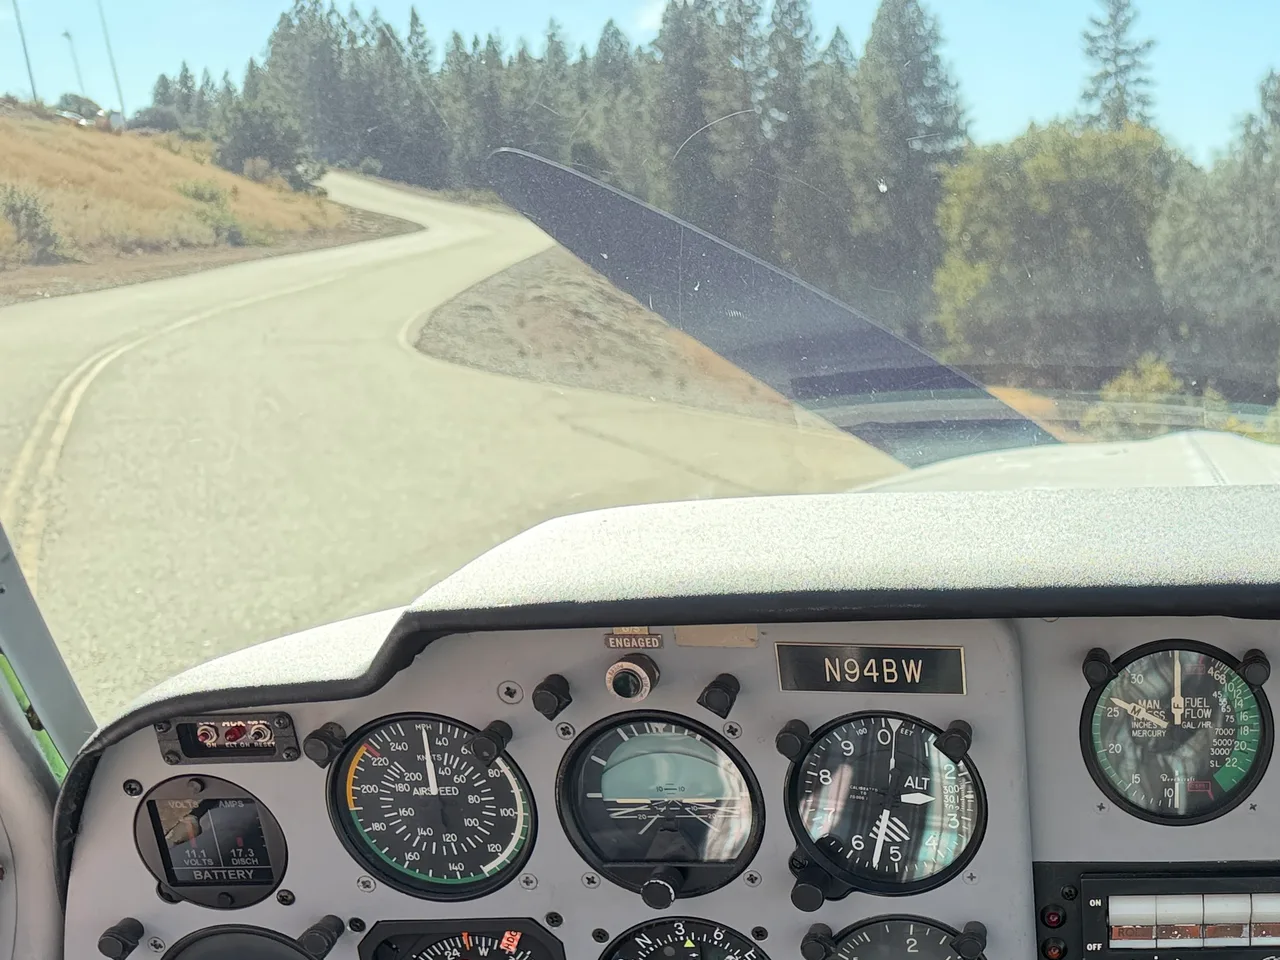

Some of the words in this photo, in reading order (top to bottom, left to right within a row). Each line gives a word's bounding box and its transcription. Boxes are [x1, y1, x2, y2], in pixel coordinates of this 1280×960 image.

[609, 636, 659, 648] ENGAGED
[824, 658, 922, 683] N94BW
[1131, 674, 1144, 684] 30
[1185, 698, 1209, 707] FUEL
[1107, 707, 1119, 717] 25
[1185, 709, 1211, 718] FLOW
[390, 742, 408, 751] 240
[436, 738, 448, 746] 40
[841, 740, 854, 756] 9
[1109, 744, 1122, 753] 20
[372, 757, 389, 766] 220
[1226, 758, 1237, 767] 22
[404, 773, 422, 781] 200
[488, 769, 500, 777] 80
[819, 769, 832, 785] 8
[944, 765, 956, 779] 2
[904, 776, 930, 789] ALT
[361, 785, 378, 794] 200
[500, 808, 515, 816] 100
[948, 813, 959, 828] 3
[852, 835, 864, 850] 6
[488, 844, 501, 852] 120
[890, 846, 901, 861] 5
[449, 863, 464, 871] 140
[193, 870, 254, 880] BATTERY
[505, 931, 517, 951] HDG
[635, 934, 652, 948] N
[907, 938, 918, 953] 2
[445, 949, 460, 960] 24
